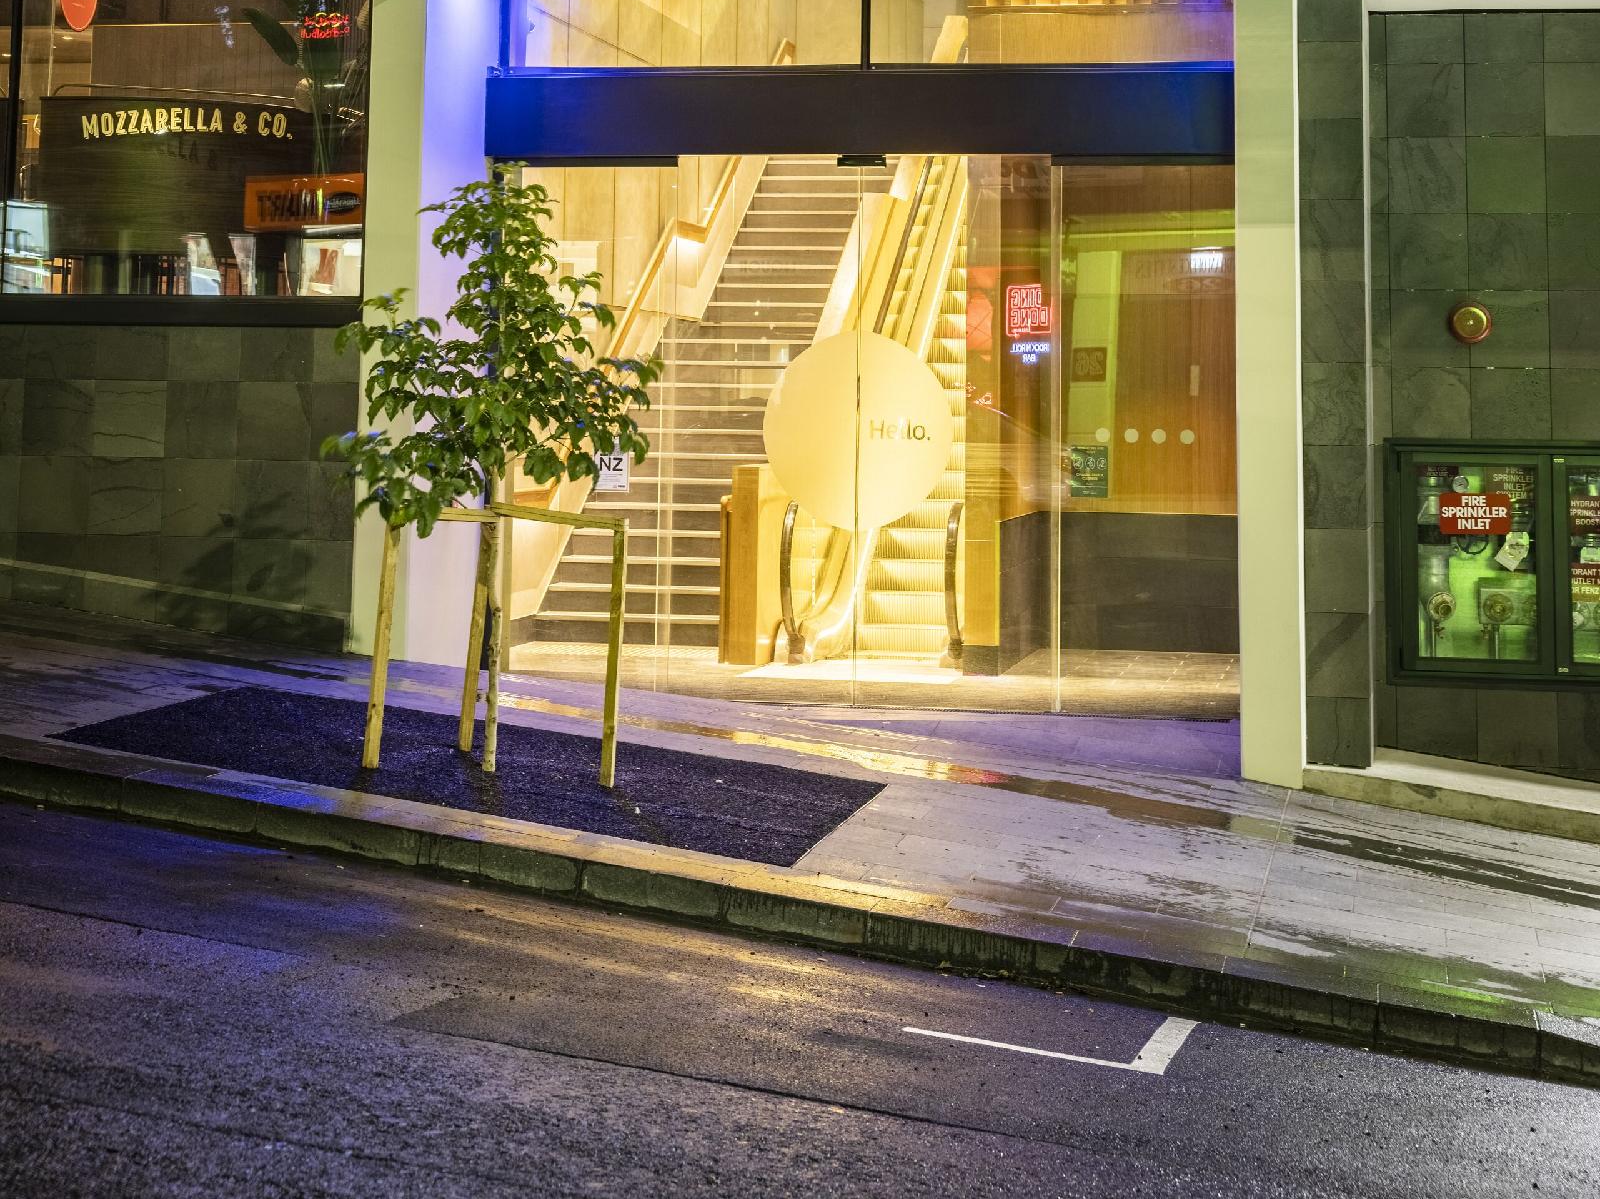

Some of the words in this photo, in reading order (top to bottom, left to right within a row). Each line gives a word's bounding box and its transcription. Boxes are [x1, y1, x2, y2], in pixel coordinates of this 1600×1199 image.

[81, 107, 223, 140] MOZZARELLA
[233, 111, 248, 134] &
[258, 111, 293, 140] CO.
[599, 457, 623, 471] NZ
[1461, 496, 1487, 506] FIRE
[1441, 507, 1507, 517] SPRINKLER
[1457, 519, 1491, 529] INLET
